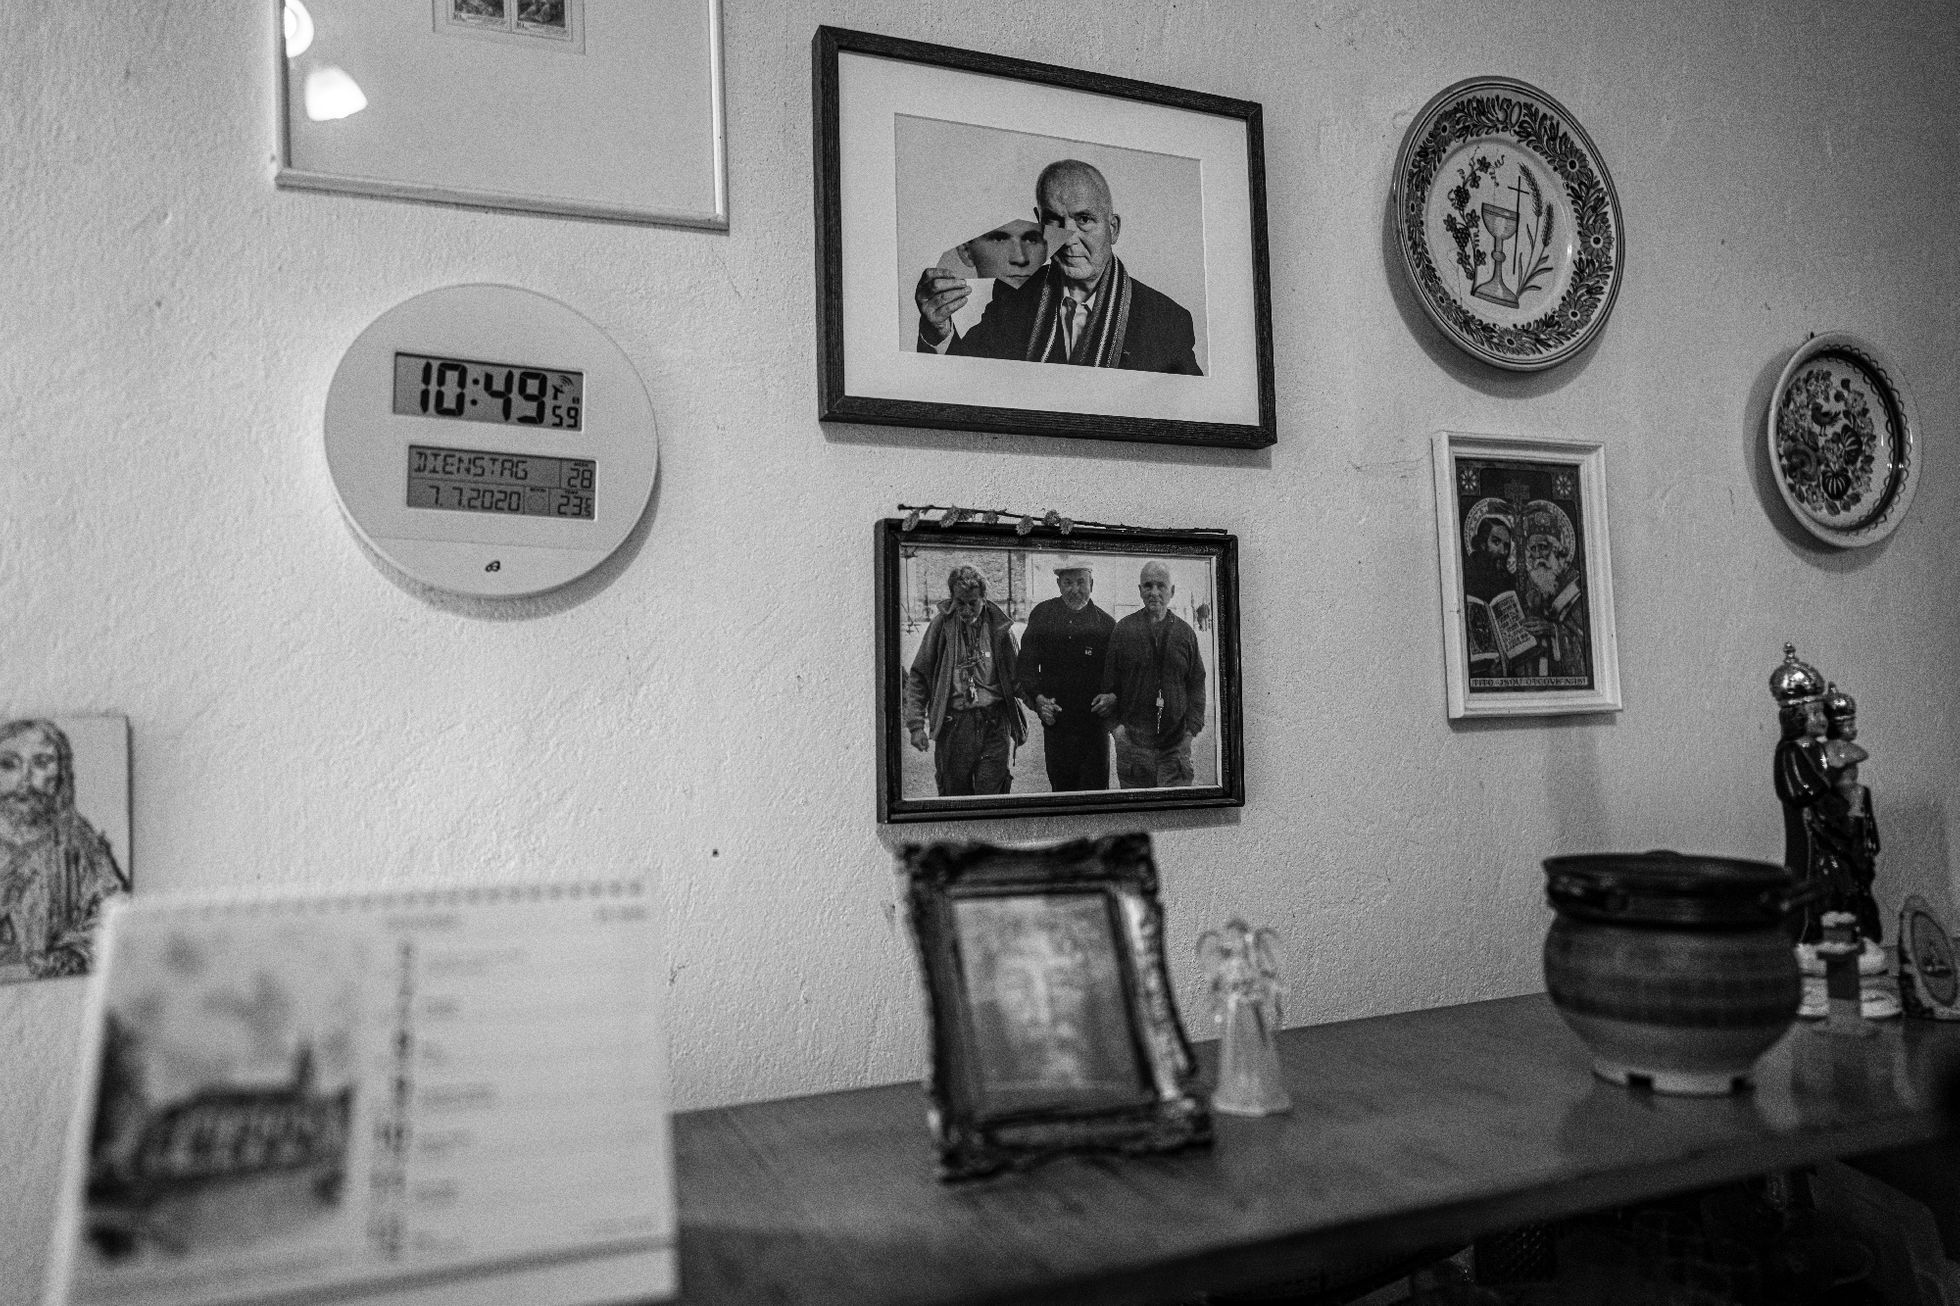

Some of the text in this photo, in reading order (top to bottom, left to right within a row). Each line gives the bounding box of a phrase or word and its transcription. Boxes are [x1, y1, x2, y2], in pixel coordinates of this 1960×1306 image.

[420, 361, 548, 425] 10:49
[552, 405, 579, 428] 59
[414, 451, 528, 480] DIENSTAG
[567, 467, 593, 488] 28
